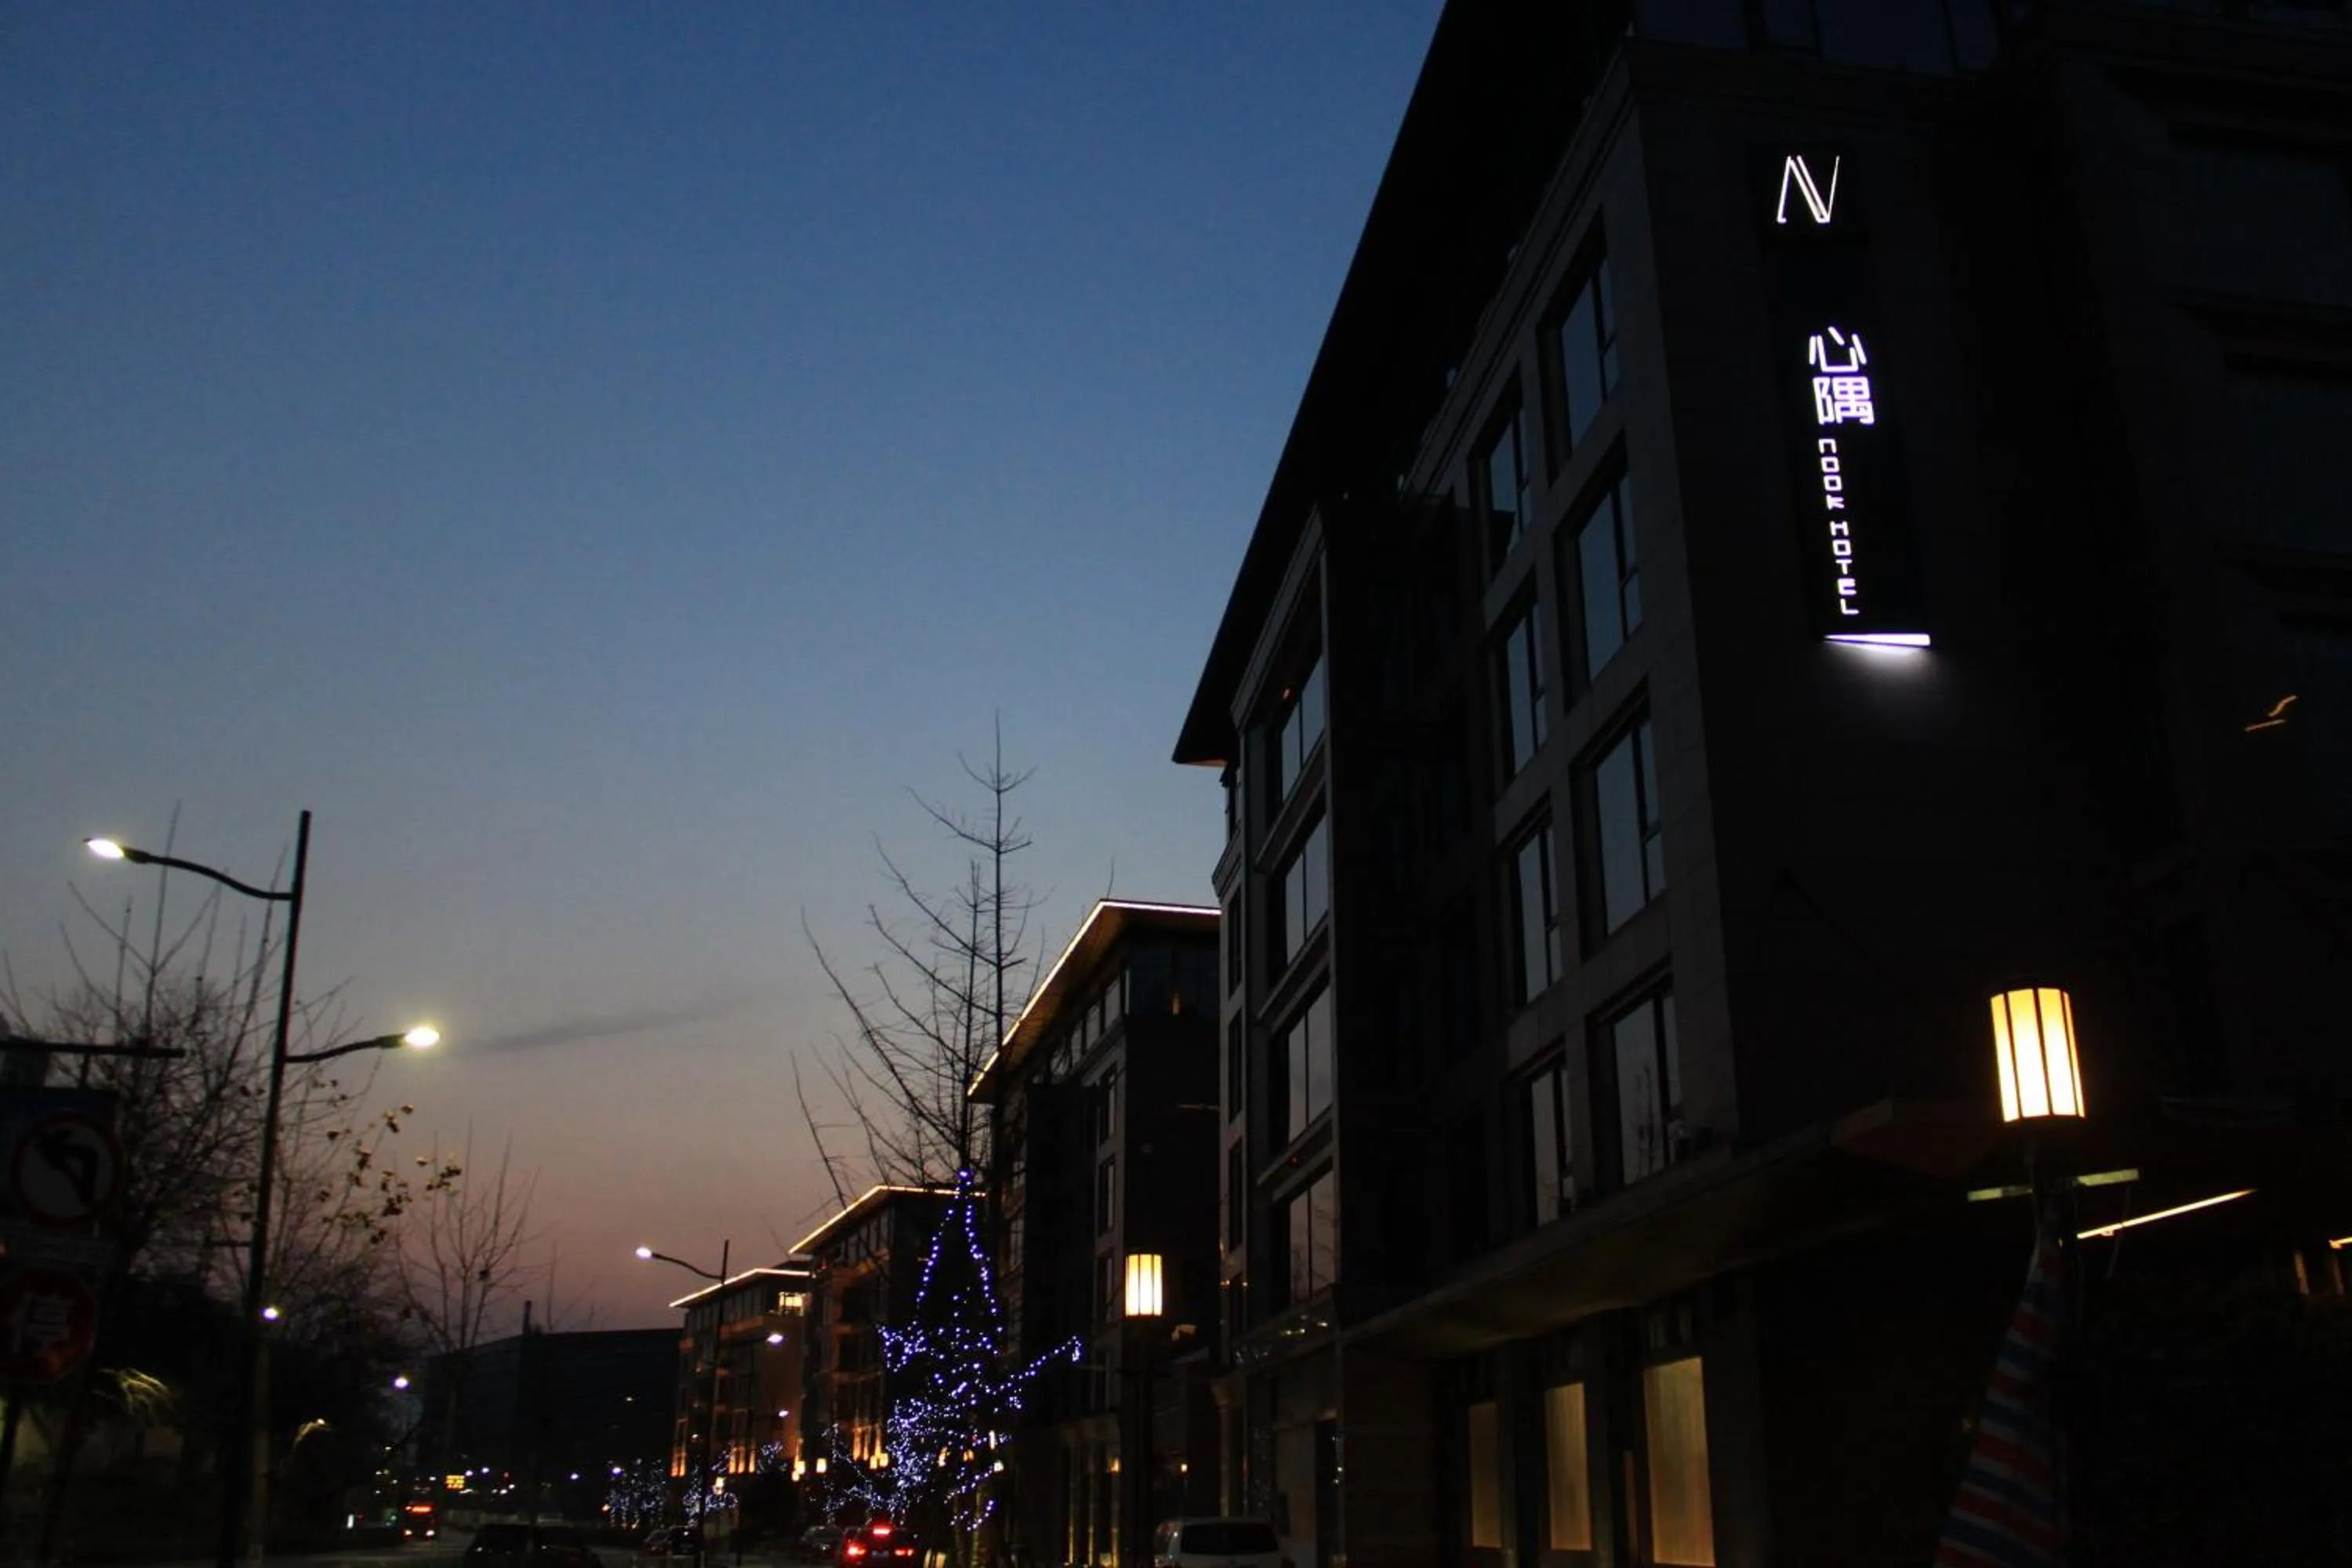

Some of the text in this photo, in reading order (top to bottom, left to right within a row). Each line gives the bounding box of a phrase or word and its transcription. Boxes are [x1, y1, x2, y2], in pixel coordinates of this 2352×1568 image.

[1809, 325, 1875, 426] 心隅
[1817, 437, 1860, 615] NOOK HOTEL
